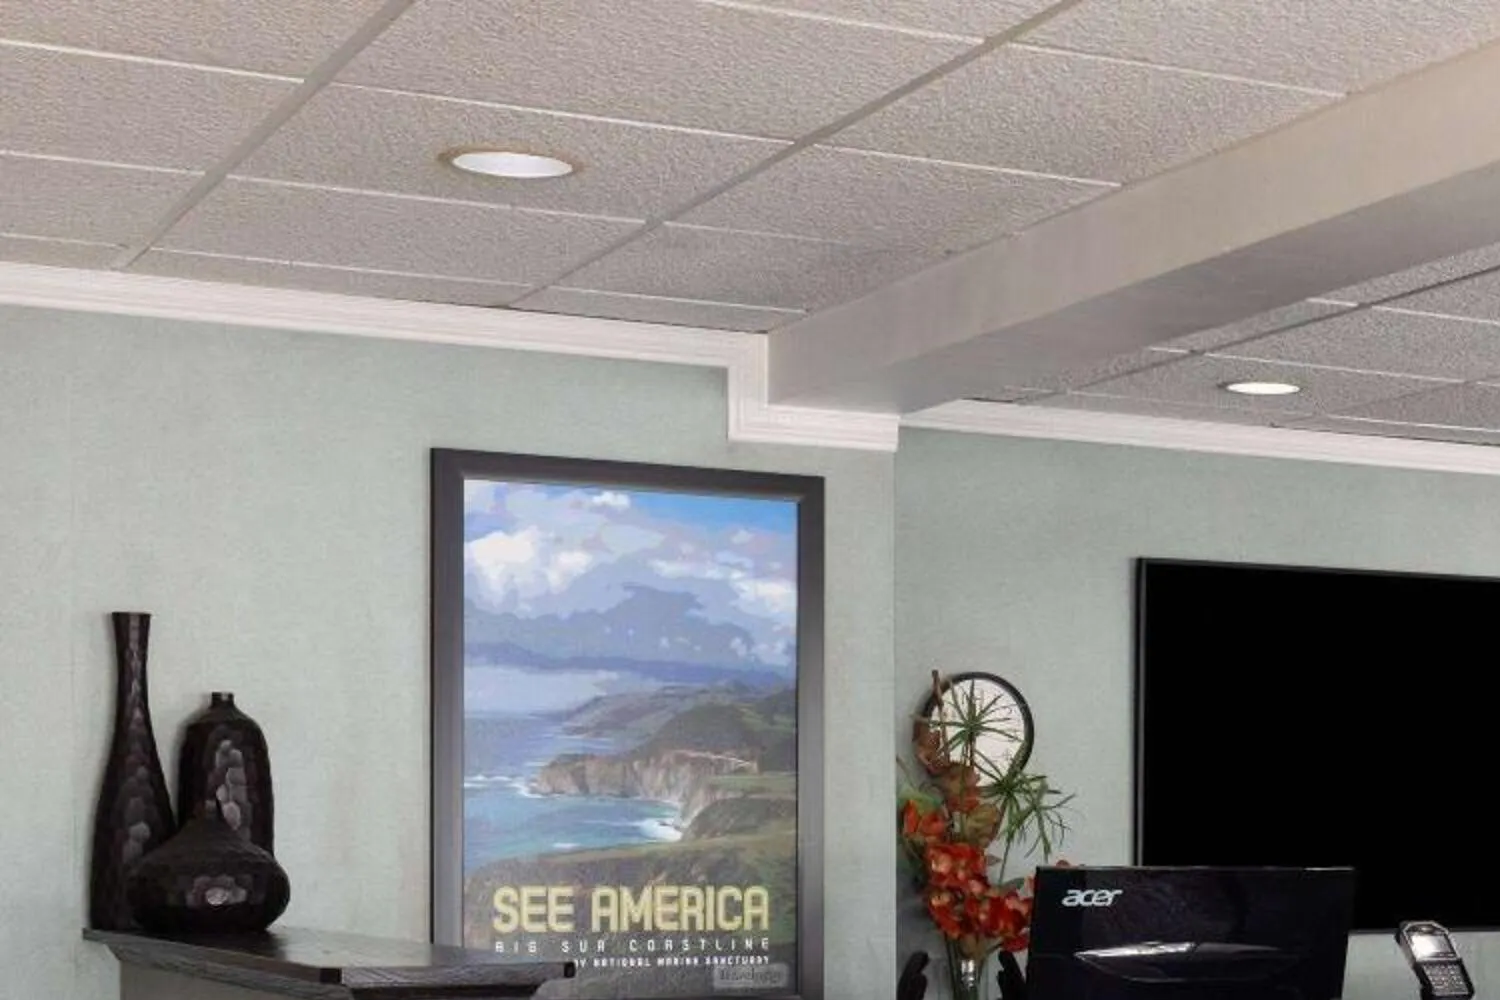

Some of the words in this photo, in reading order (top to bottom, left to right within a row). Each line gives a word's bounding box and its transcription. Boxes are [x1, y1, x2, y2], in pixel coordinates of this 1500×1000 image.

[1062, 889, 1123, 907] acer
[492, 885, 575, 933] SEE
[591, 885, 769, 932] AMERICA
[495, 941, 537, 953] BIG
[561, 939, 605, 953] SUR
[629, 937, 770, 952] COASTLINE
[593, 957, 651, 969] NATIONAL
[657, 957, 699, 968] MARINE
